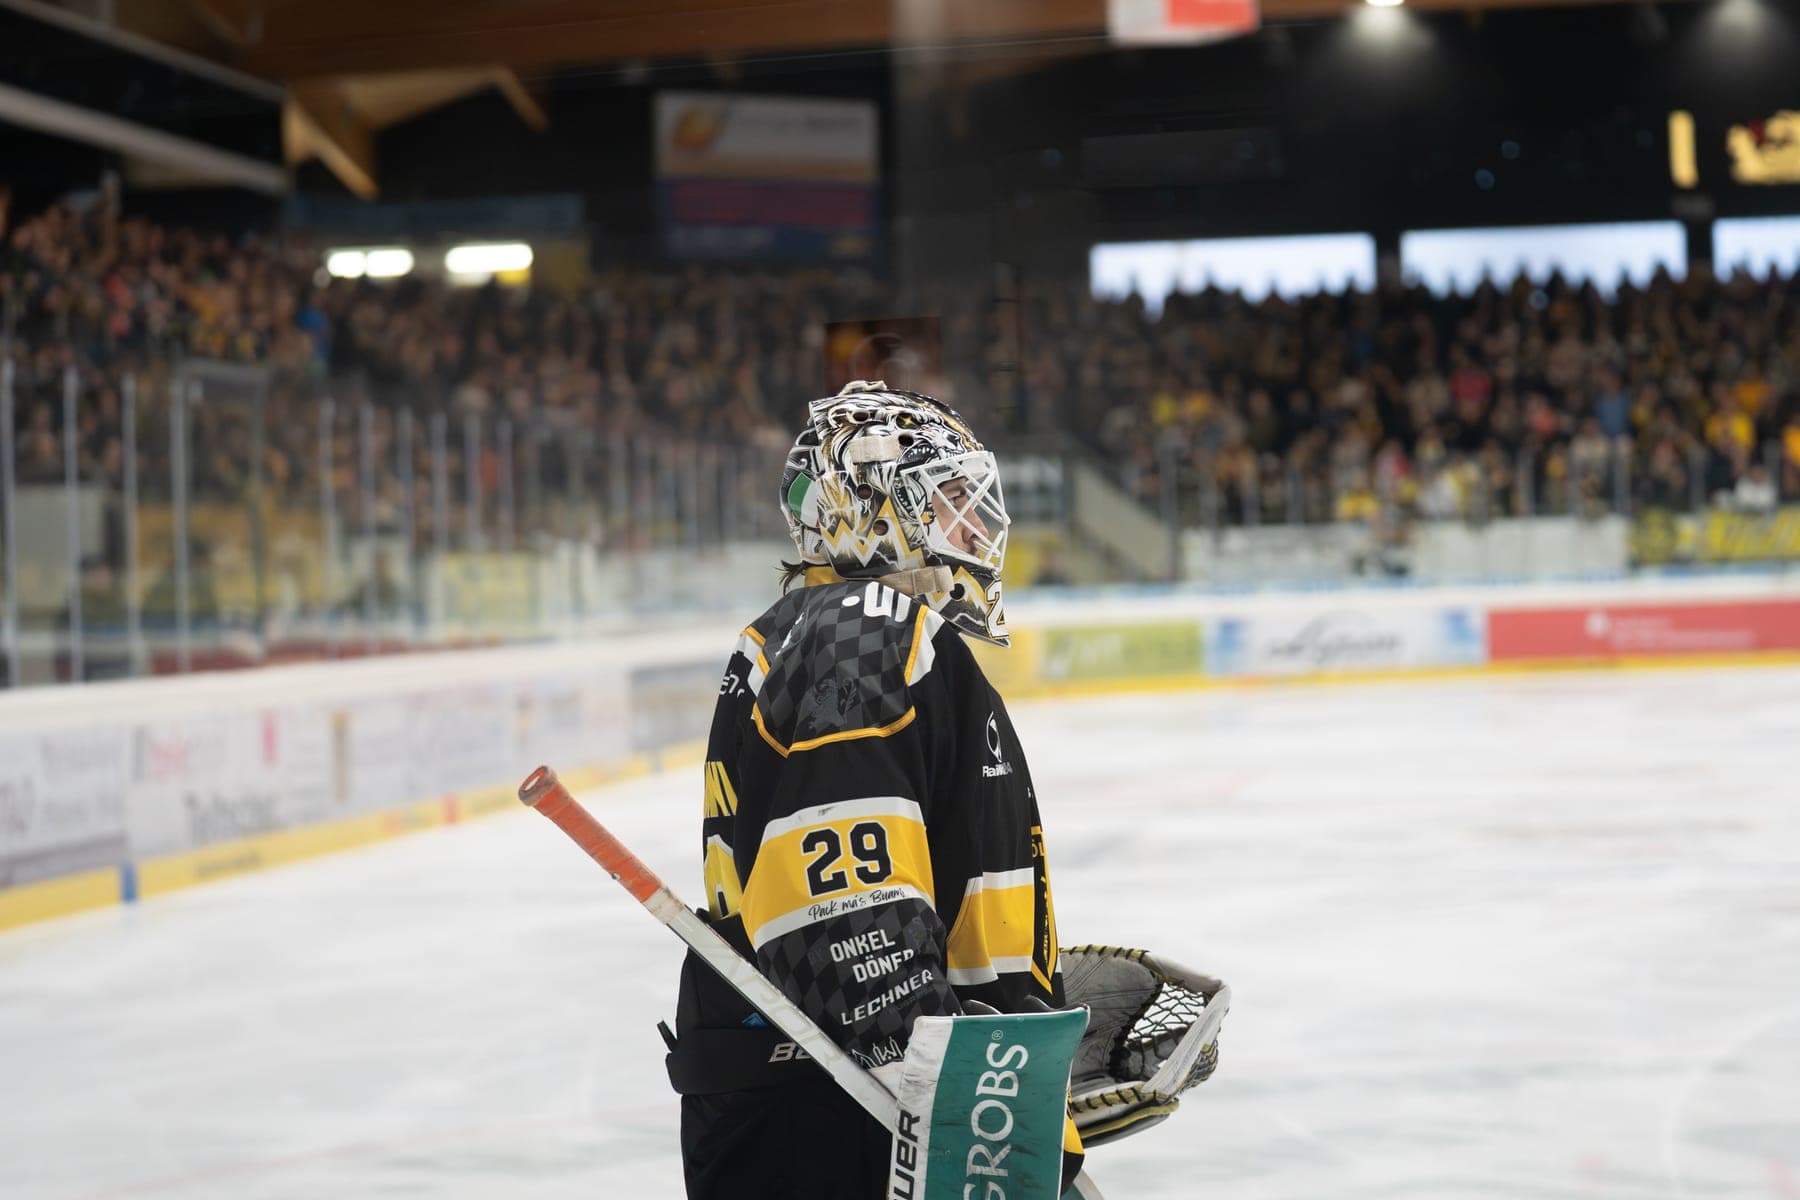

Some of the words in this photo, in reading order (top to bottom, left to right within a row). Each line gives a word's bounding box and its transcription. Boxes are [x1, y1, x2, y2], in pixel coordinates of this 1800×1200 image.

[801, 821, 893, 898] 29
[808, 900, 838, 921] Pack
[829, 928, 896, 963] ONKEL
[841, 968, 934, 1025] LECHNER
